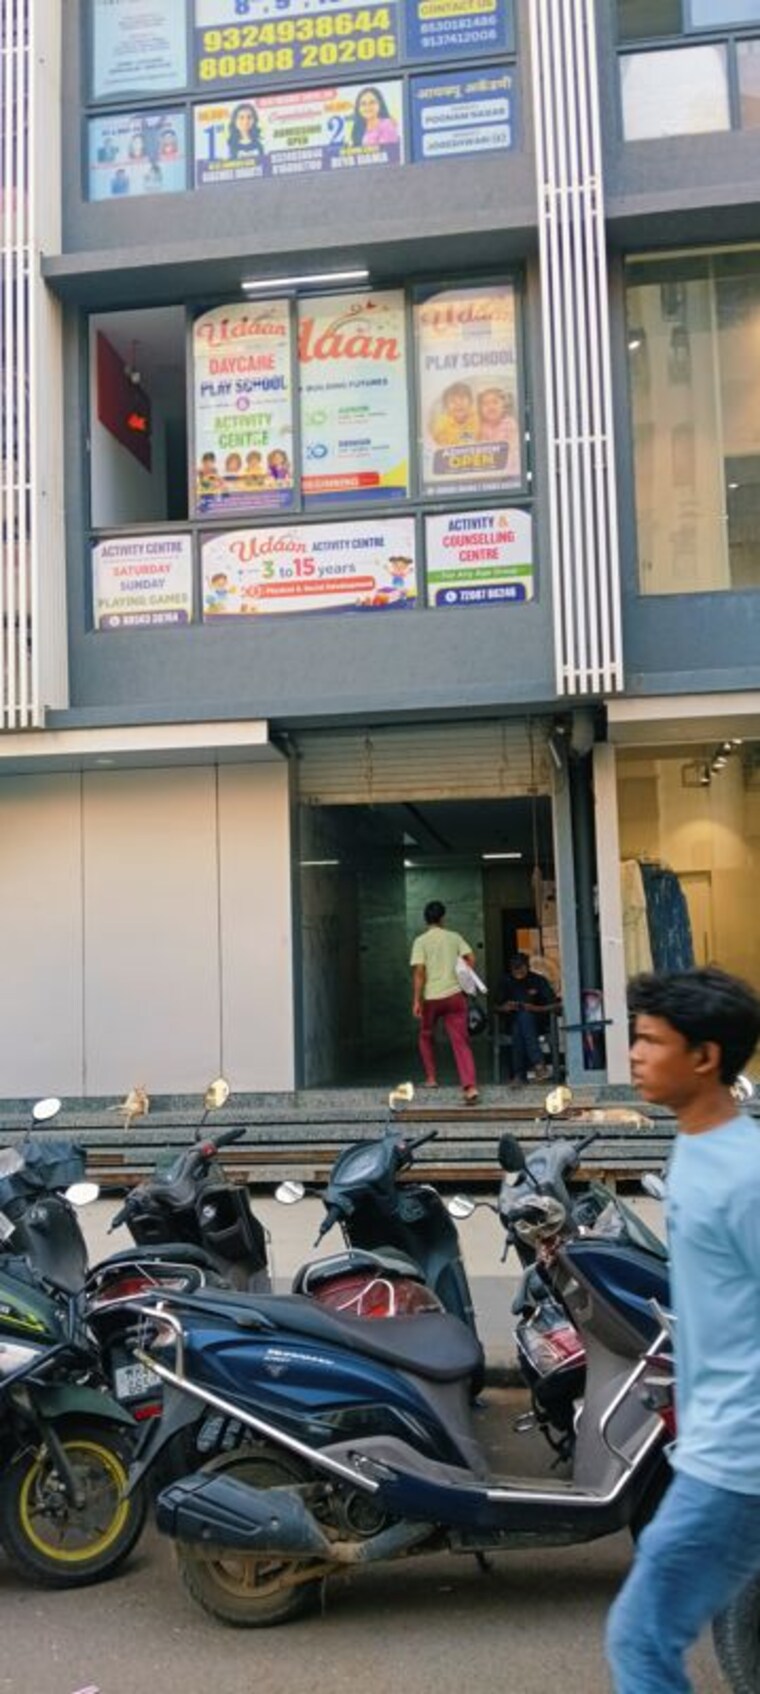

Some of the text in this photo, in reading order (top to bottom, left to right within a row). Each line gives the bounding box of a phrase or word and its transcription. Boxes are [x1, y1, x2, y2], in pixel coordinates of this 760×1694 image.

[420, 1, 474, 16] CONTACT
[203, 8, 391, 52] 9324938644
[199, 48, 294, 80] 80808
[300, 35, 396, 68] 20206
[197, 318, 286, 347] Udaan
[209, 354, 276, 375] DAYCARE
[425, 351, 515, 371] PLAY SCHOOL
[200, 376, 288, 398] PLAY SCHOOL
[349, 378, 388, 388] FUTURES
[214, 413, 273, 430] ACTIVITY
[218, 431, 269, 449] CENTRE
[449, 453, 494, 469] OPEN
[448, 515, 508, 532] ACTIVITY &
[442, 532, 516, 548] COUNSELLING
[101, 541, 183, 558] ACTIVITY CENTRE
[229, 536, 385, 562] Udaan ACTIVITY CENTRE
[459, 548, 499, 562] CENTRE
[112, 564, 171, 577] SATURDAY
[262, 557, 356, 578] 3 to 15 years
[457, 569, 473, 581] Any
[120, 579, 165, 591] SUNDAY
[98, 593, 188, 609] PLAYING GAMES
